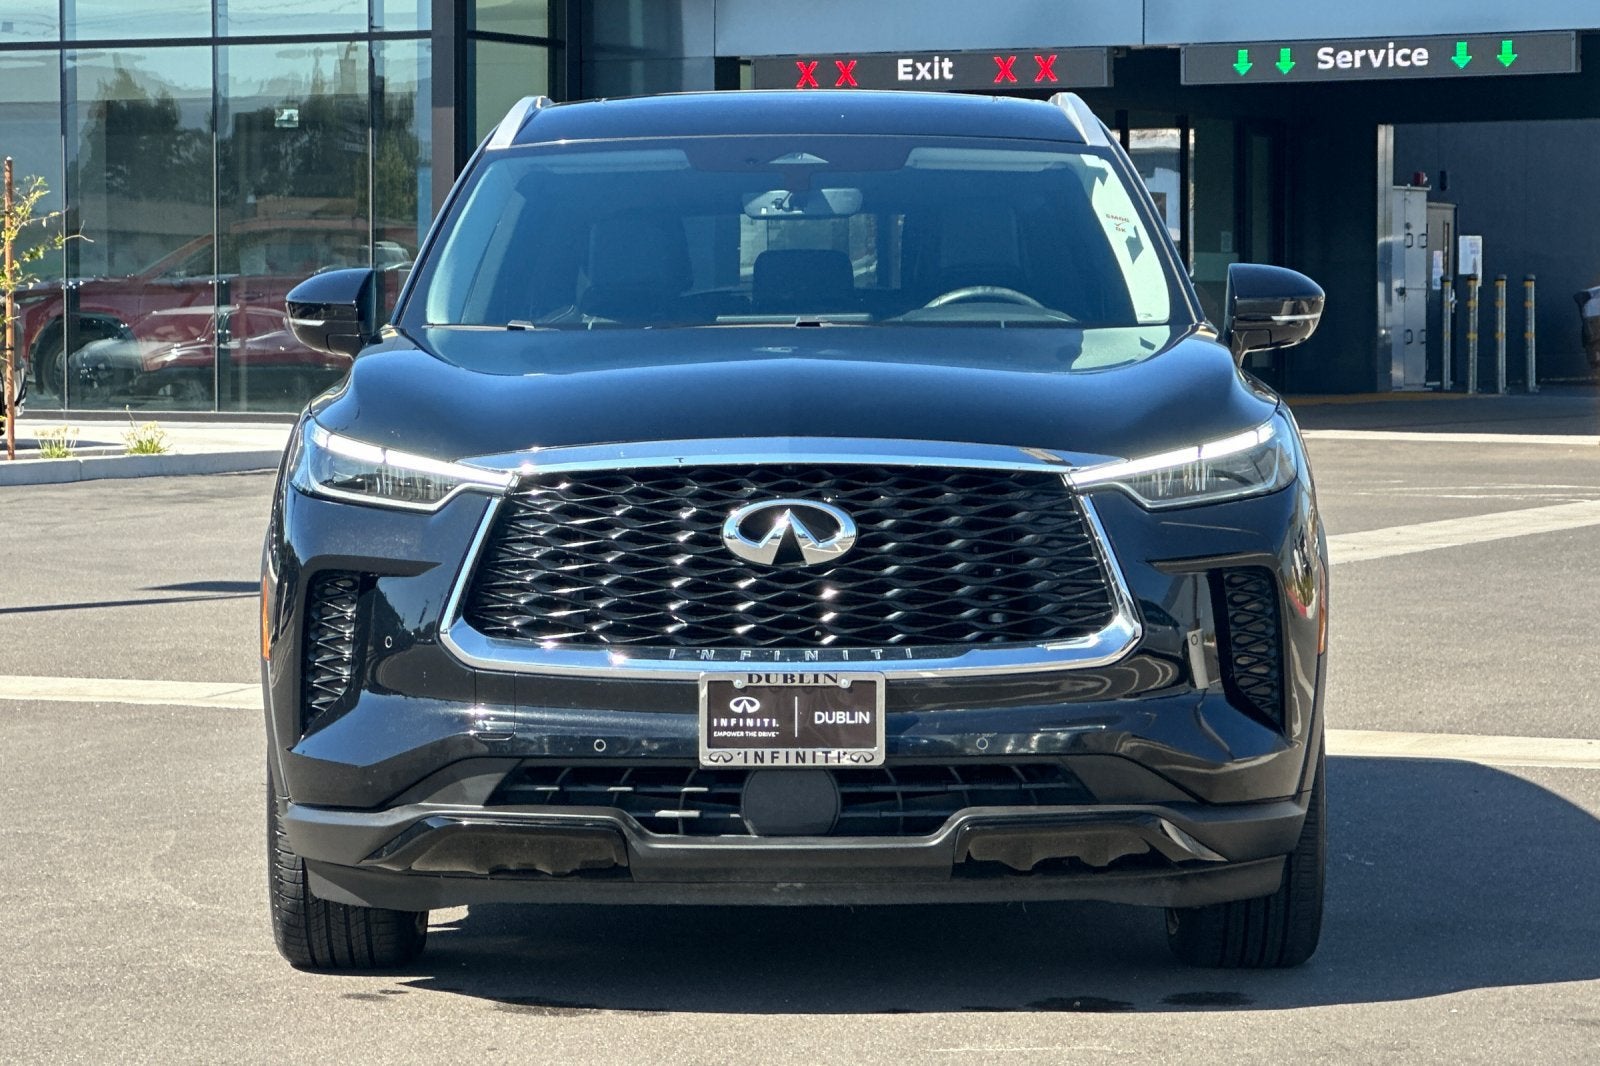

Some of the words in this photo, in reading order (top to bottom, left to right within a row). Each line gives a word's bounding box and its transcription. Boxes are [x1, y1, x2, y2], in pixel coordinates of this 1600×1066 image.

[1317, 42, 1429, 70] Service
[897, 56, 954, 81] Exit
[668, 648, 912, 661] INFINITI
[748, 673, 838, 684] DUBLIN
[814, 711, 870, 725] DUBLIN
[744, 751, 841, 764] INFINITI
